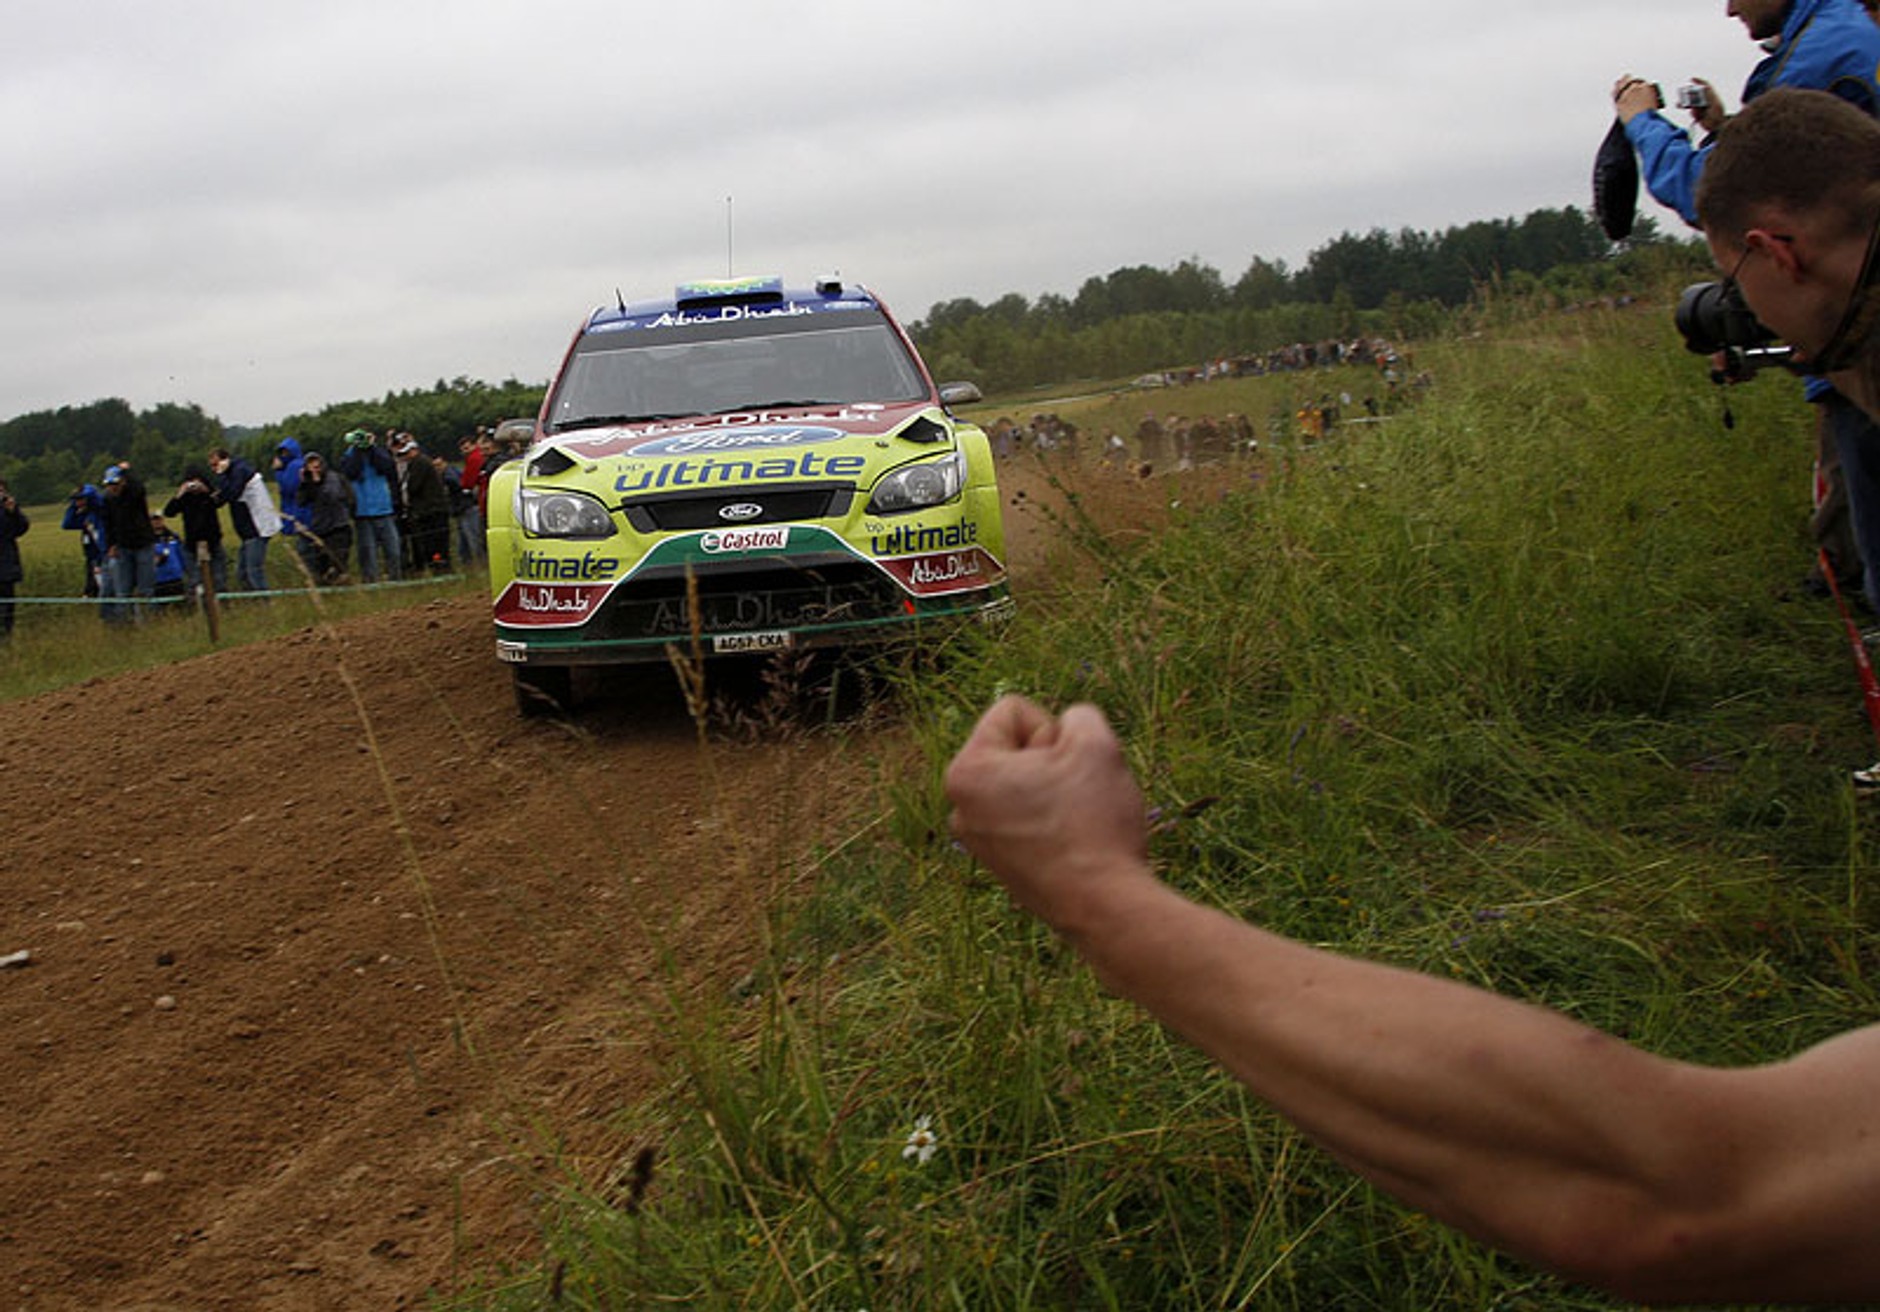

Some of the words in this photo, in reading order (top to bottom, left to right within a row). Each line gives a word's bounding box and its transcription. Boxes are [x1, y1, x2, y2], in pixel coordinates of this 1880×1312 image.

[614, 452, 866, 493] ultimate
[721, 531, 784, 549] Castrol
[871, 516, 977, 556] ultimate
[512, 551, 620, 579] ltimate
